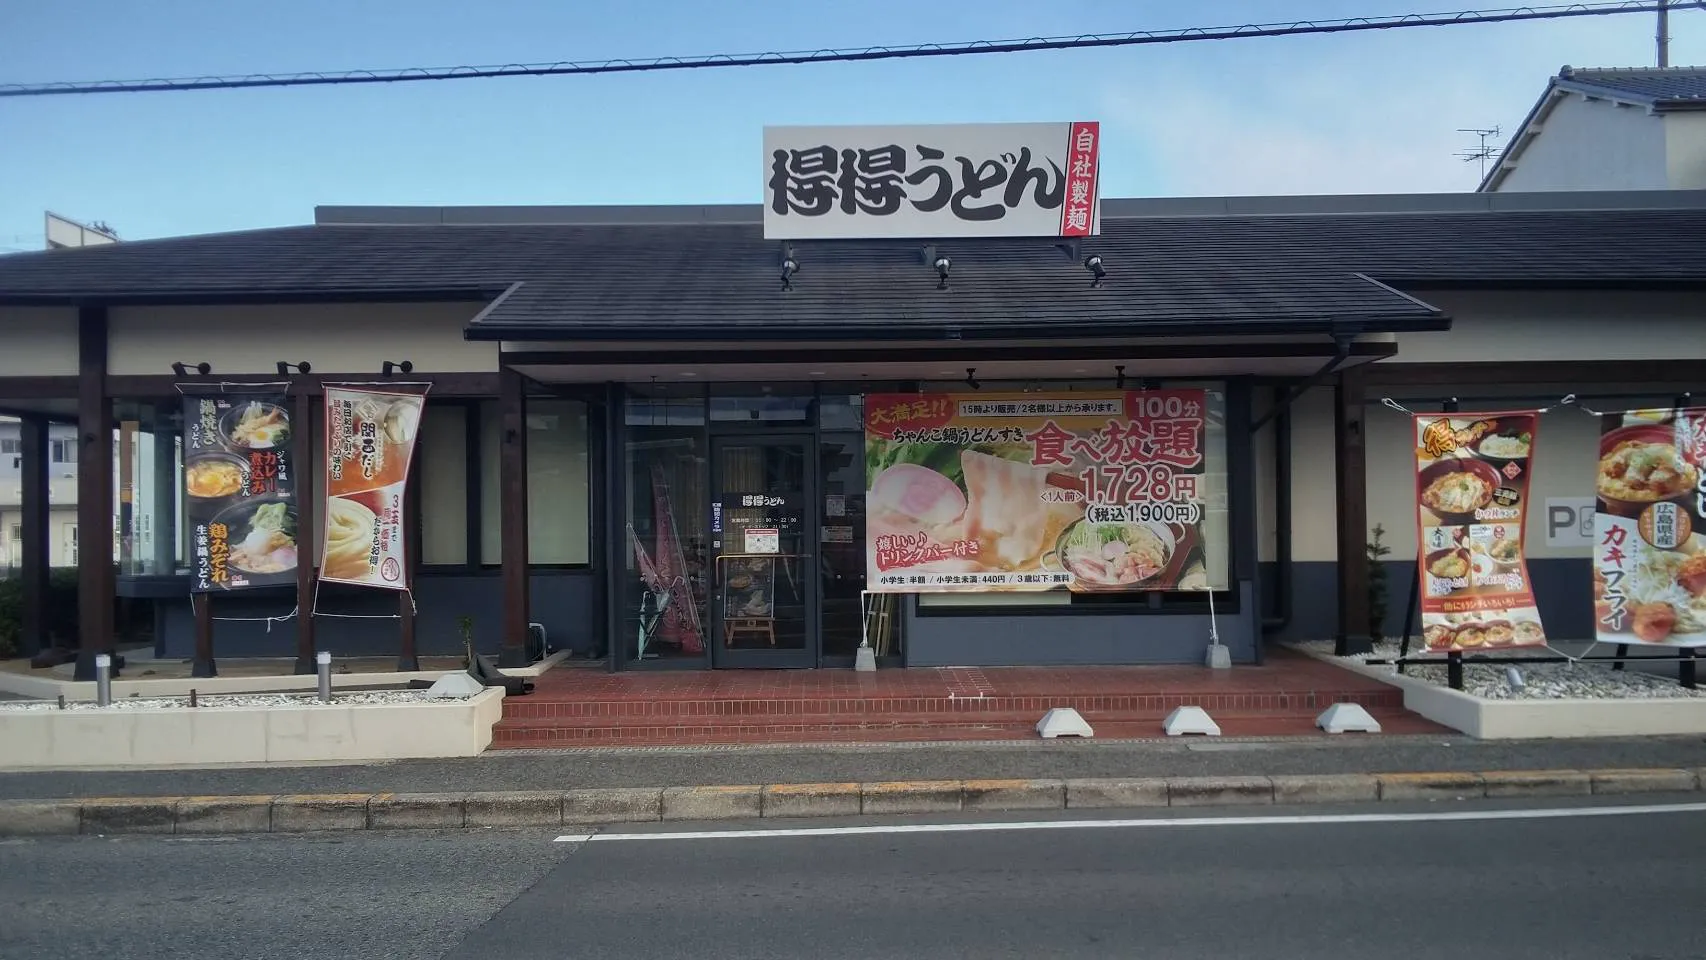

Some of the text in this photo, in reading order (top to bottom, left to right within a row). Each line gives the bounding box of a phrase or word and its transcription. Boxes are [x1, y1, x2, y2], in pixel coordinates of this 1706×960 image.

[769, 145, 1065, 221] 得得うどん
[1066, 128, 1095, 231] 自社製麺
[200, 399, 217, 445] 鍋焼き
[870, 399, 946, 425] 大満足!!
[1135, 397, 1200, 418] 100分
[191, 423, 201, 449] うどん
[892, 426, 1024, 444] ちゃんこ鍋うどんすき
[1025, 419, 1201, 467] 食べ放題
[250, 452, 266, 495] 煮込み
[264, 452, 277, 492] カレー
[276, 450, 288, 481] ジャワ風
[241, 471, 251, 497] うどん
[1082, 467, 1198, 503] 1,728円
[1087, 505, 1200, 524] (税込1,900円)
[1548, 505, 1576, 538] P
[209, 523, 230, 583] 鶏みぞれ
[878, 541, 980, 566] ドリンクバー付き
[1601, 524, 1628, 631] カキフライ
